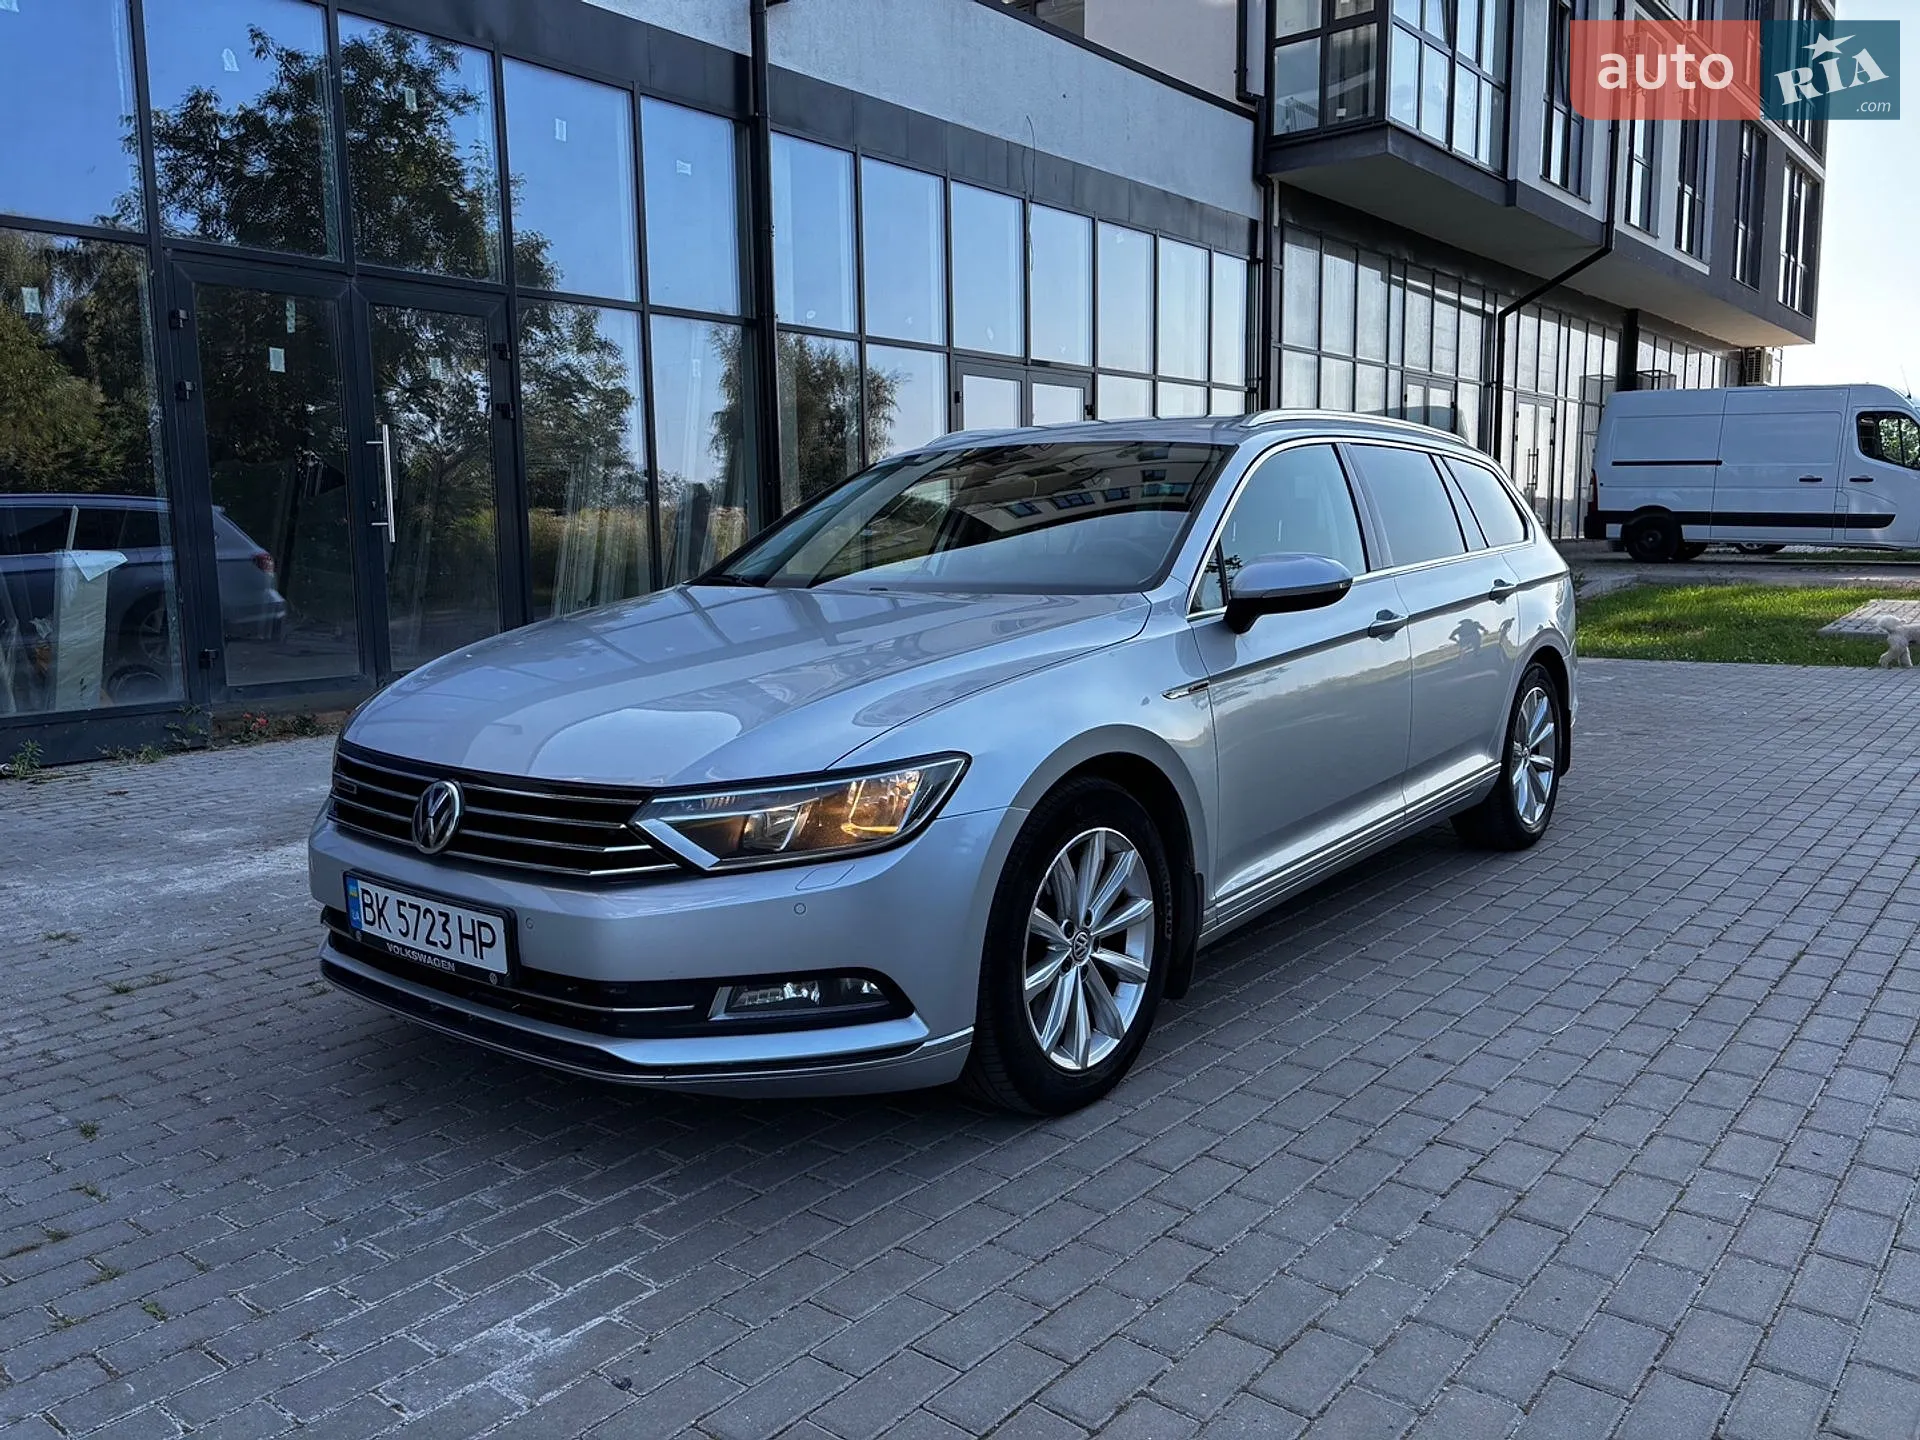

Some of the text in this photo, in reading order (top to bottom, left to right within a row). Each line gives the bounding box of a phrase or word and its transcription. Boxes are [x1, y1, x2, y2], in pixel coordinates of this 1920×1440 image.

[361, 888, 496, 960] BK 5723 HP
[386, 942, 455, 971] VOLKSWAGEN
